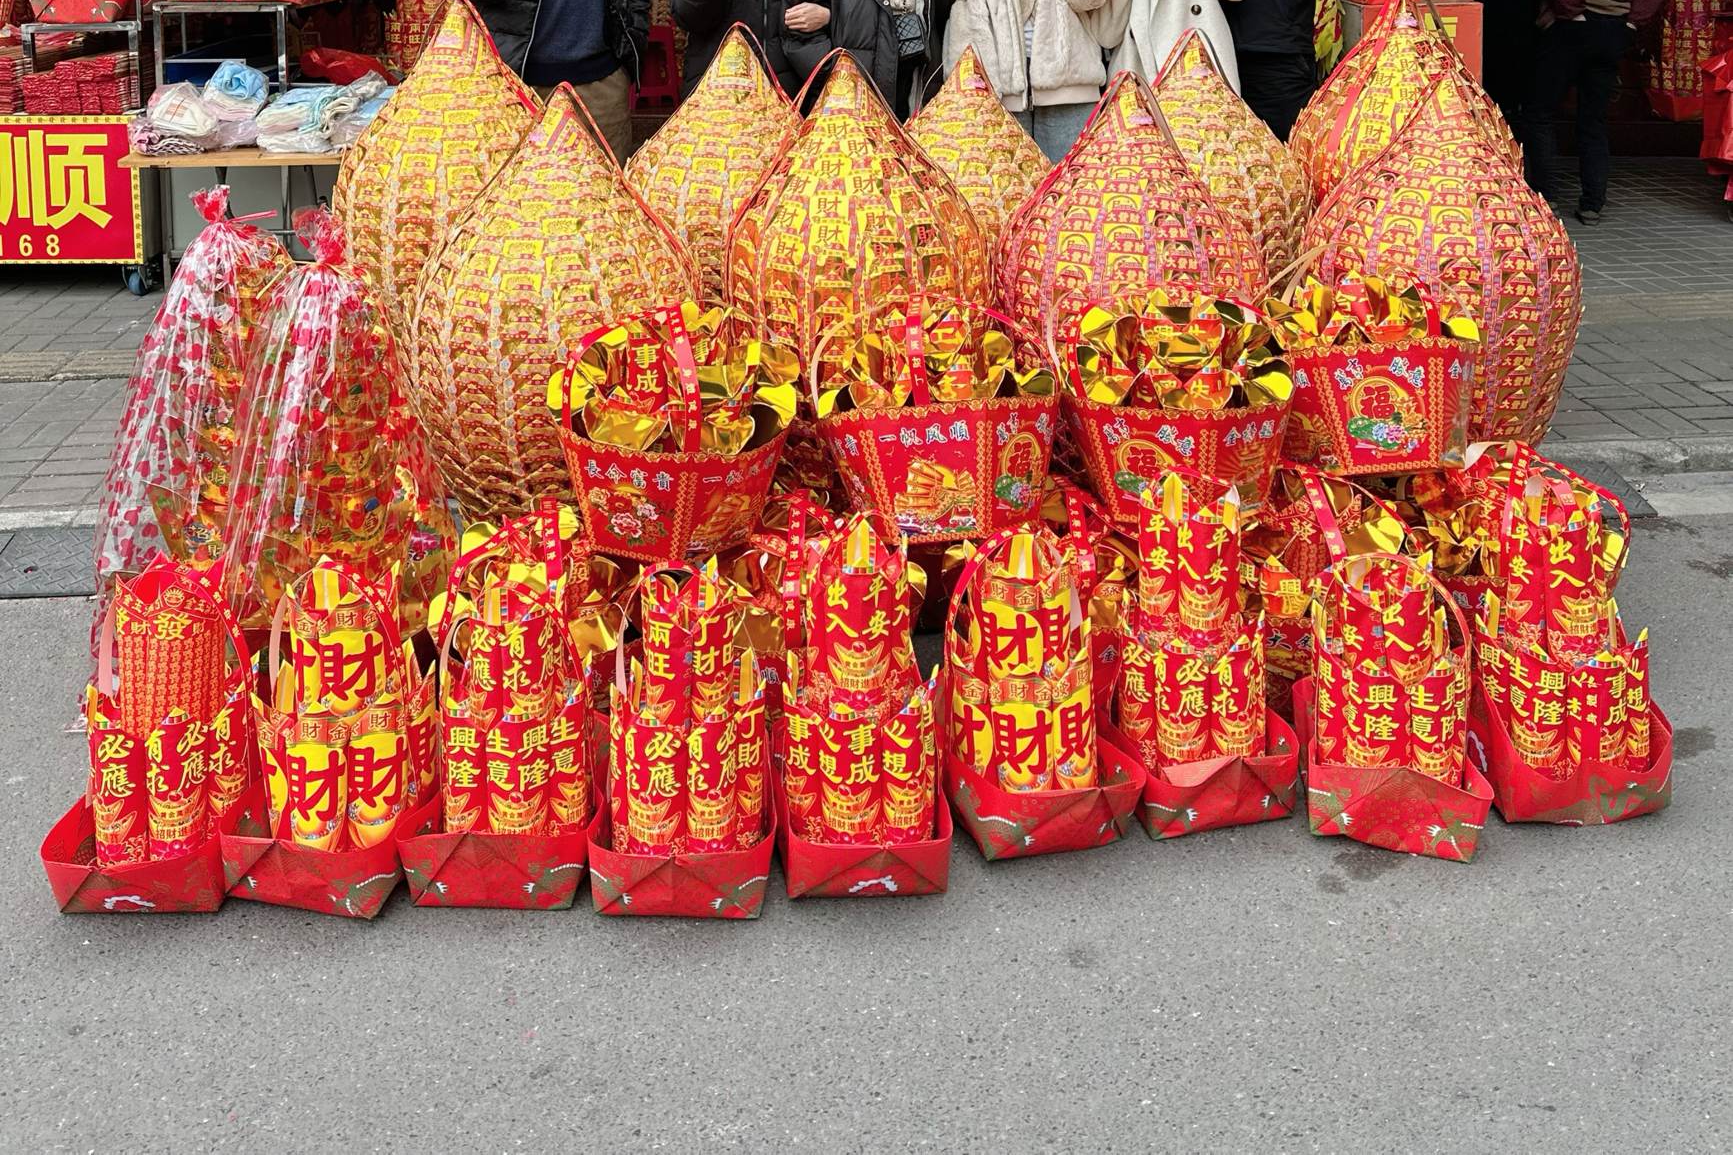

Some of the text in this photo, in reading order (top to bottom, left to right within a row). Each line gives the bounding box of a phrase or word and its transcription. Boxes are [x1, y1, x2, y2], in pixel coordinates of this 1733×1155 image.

[633, 343, 663, 393] 事成
[1361, 384, 1396, 419] 福
[584, 459, 673, 491] 長命富貴
[1145, 514, 1176, 574] 平安
[1204, 526, 1230, 585] 平安
[1508, 520, 1533, 584] 平安
[1548, 537, 1586, 589] 出入
[827, 581, 858, 639] 出入
[861, 574, 891, 641] 平安
[1382, 603, 1414, 652] 出入
[319, 633, 384, 702] 財
[471, 624, 496, 692] 必應
[501, 622, 531, 693] 有求
[648, 620, 675, 681] 兩旺
[693, 614, 720, 676] 丁財
[981, 611, 1039, 672] 財
[1123, 640, 1152, 703] 必應
[1176, 657, 1209, 718] 必應
[1211, 654, 1238, 714] 有求
[1319, 658, 1337, 719] 興隆
[1479, 643, 1507, 704] 興隆
[1508, 656, 1533, 717] 生意
[1533, 669, 1567, 725] 興隆
[1605, 673, 1628, 726] 事成
[208, 708, 236, 775] 有求
[737, 705, 766, 771] 丁財
[992, 709, 1053, 775] 財
[1364, 684, 1399, 742] 興隆
[1411, 685, 1439, 744] 生意
[98, 734, 136, 798] 必應
[177, 721, 209, 792] 必應
[348, 735, 407, 808] 財
[447, 726, 481, 788] 興隆
[487, 727, 516, 792] 生意
[518, 725, 549, 792] 興隆
[550, 717, 579, 778] 生意
[646, 730, 682, 798] 必應
[686, 727, 709, 792] 有求
[786, 714, 818, 776] 事成
[845, 723, 880, 786] 事成
[287, 750, 347, 822] 財
